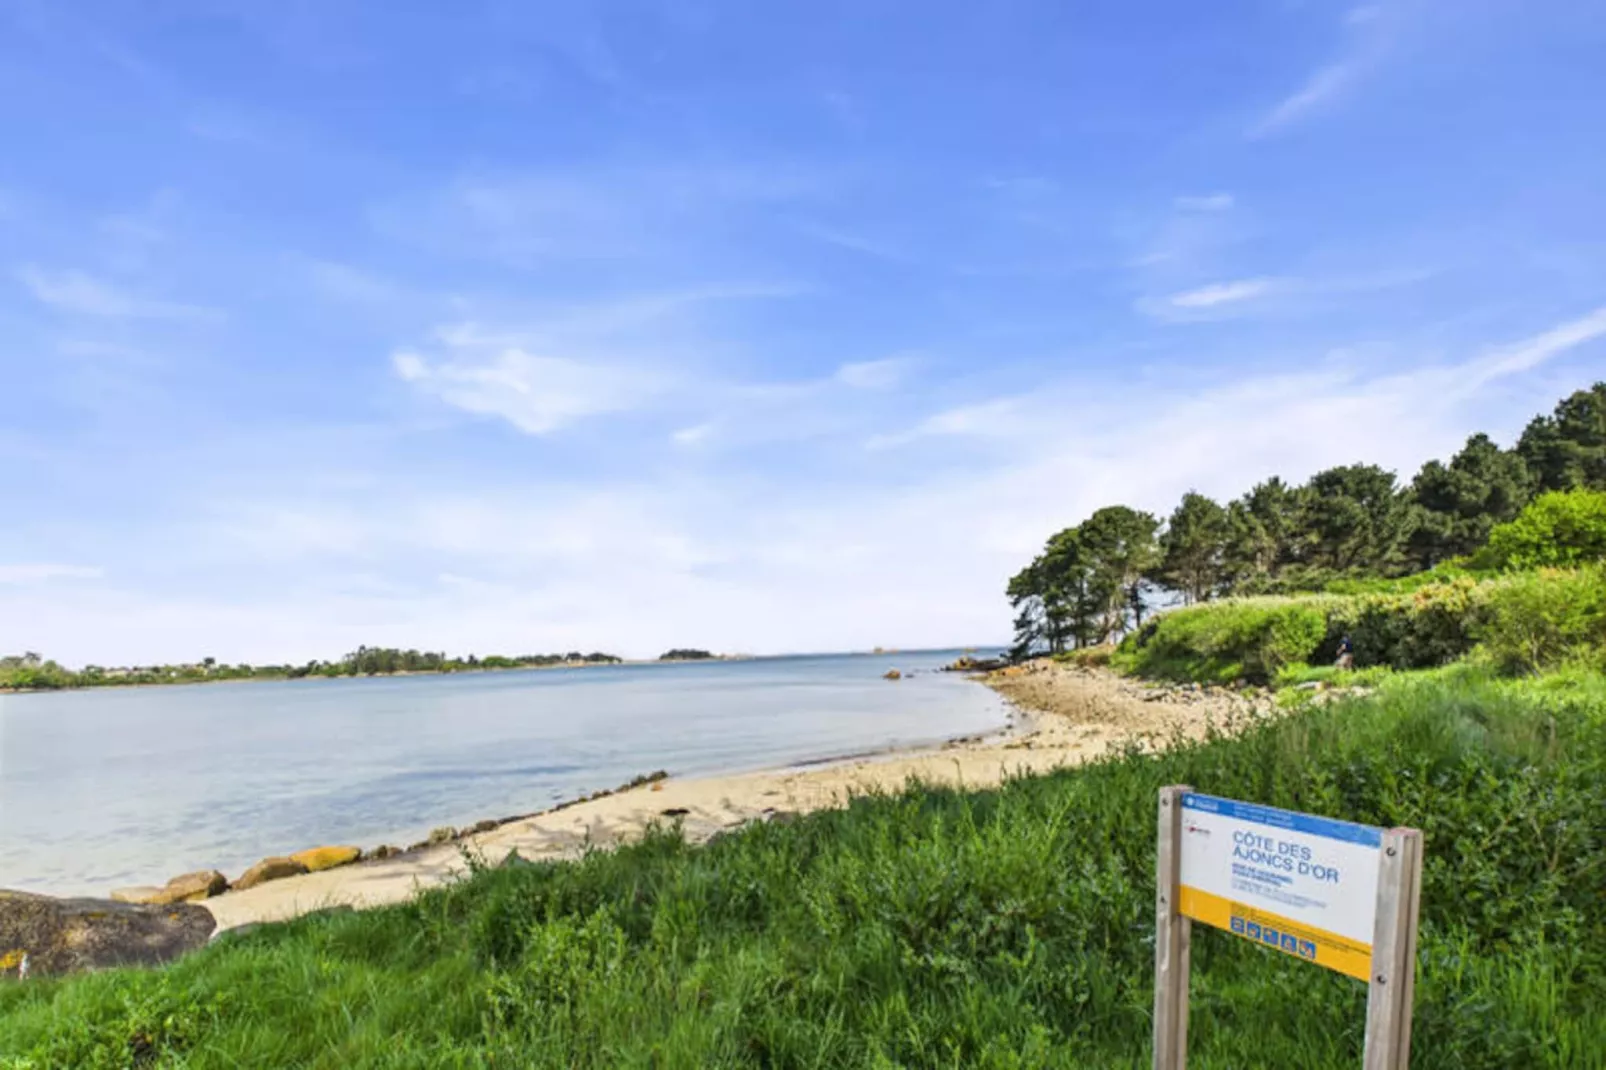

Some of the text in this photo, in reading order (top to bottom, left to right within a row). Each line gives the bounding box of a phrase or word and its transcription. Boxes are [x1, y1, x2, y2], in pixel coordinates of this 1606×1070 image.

[1233, 831, 1312, 861] CÔTE DES
[1233, 846, 1293, 872] AJONCS
[1298, 862, 1339, 884] D'OR
